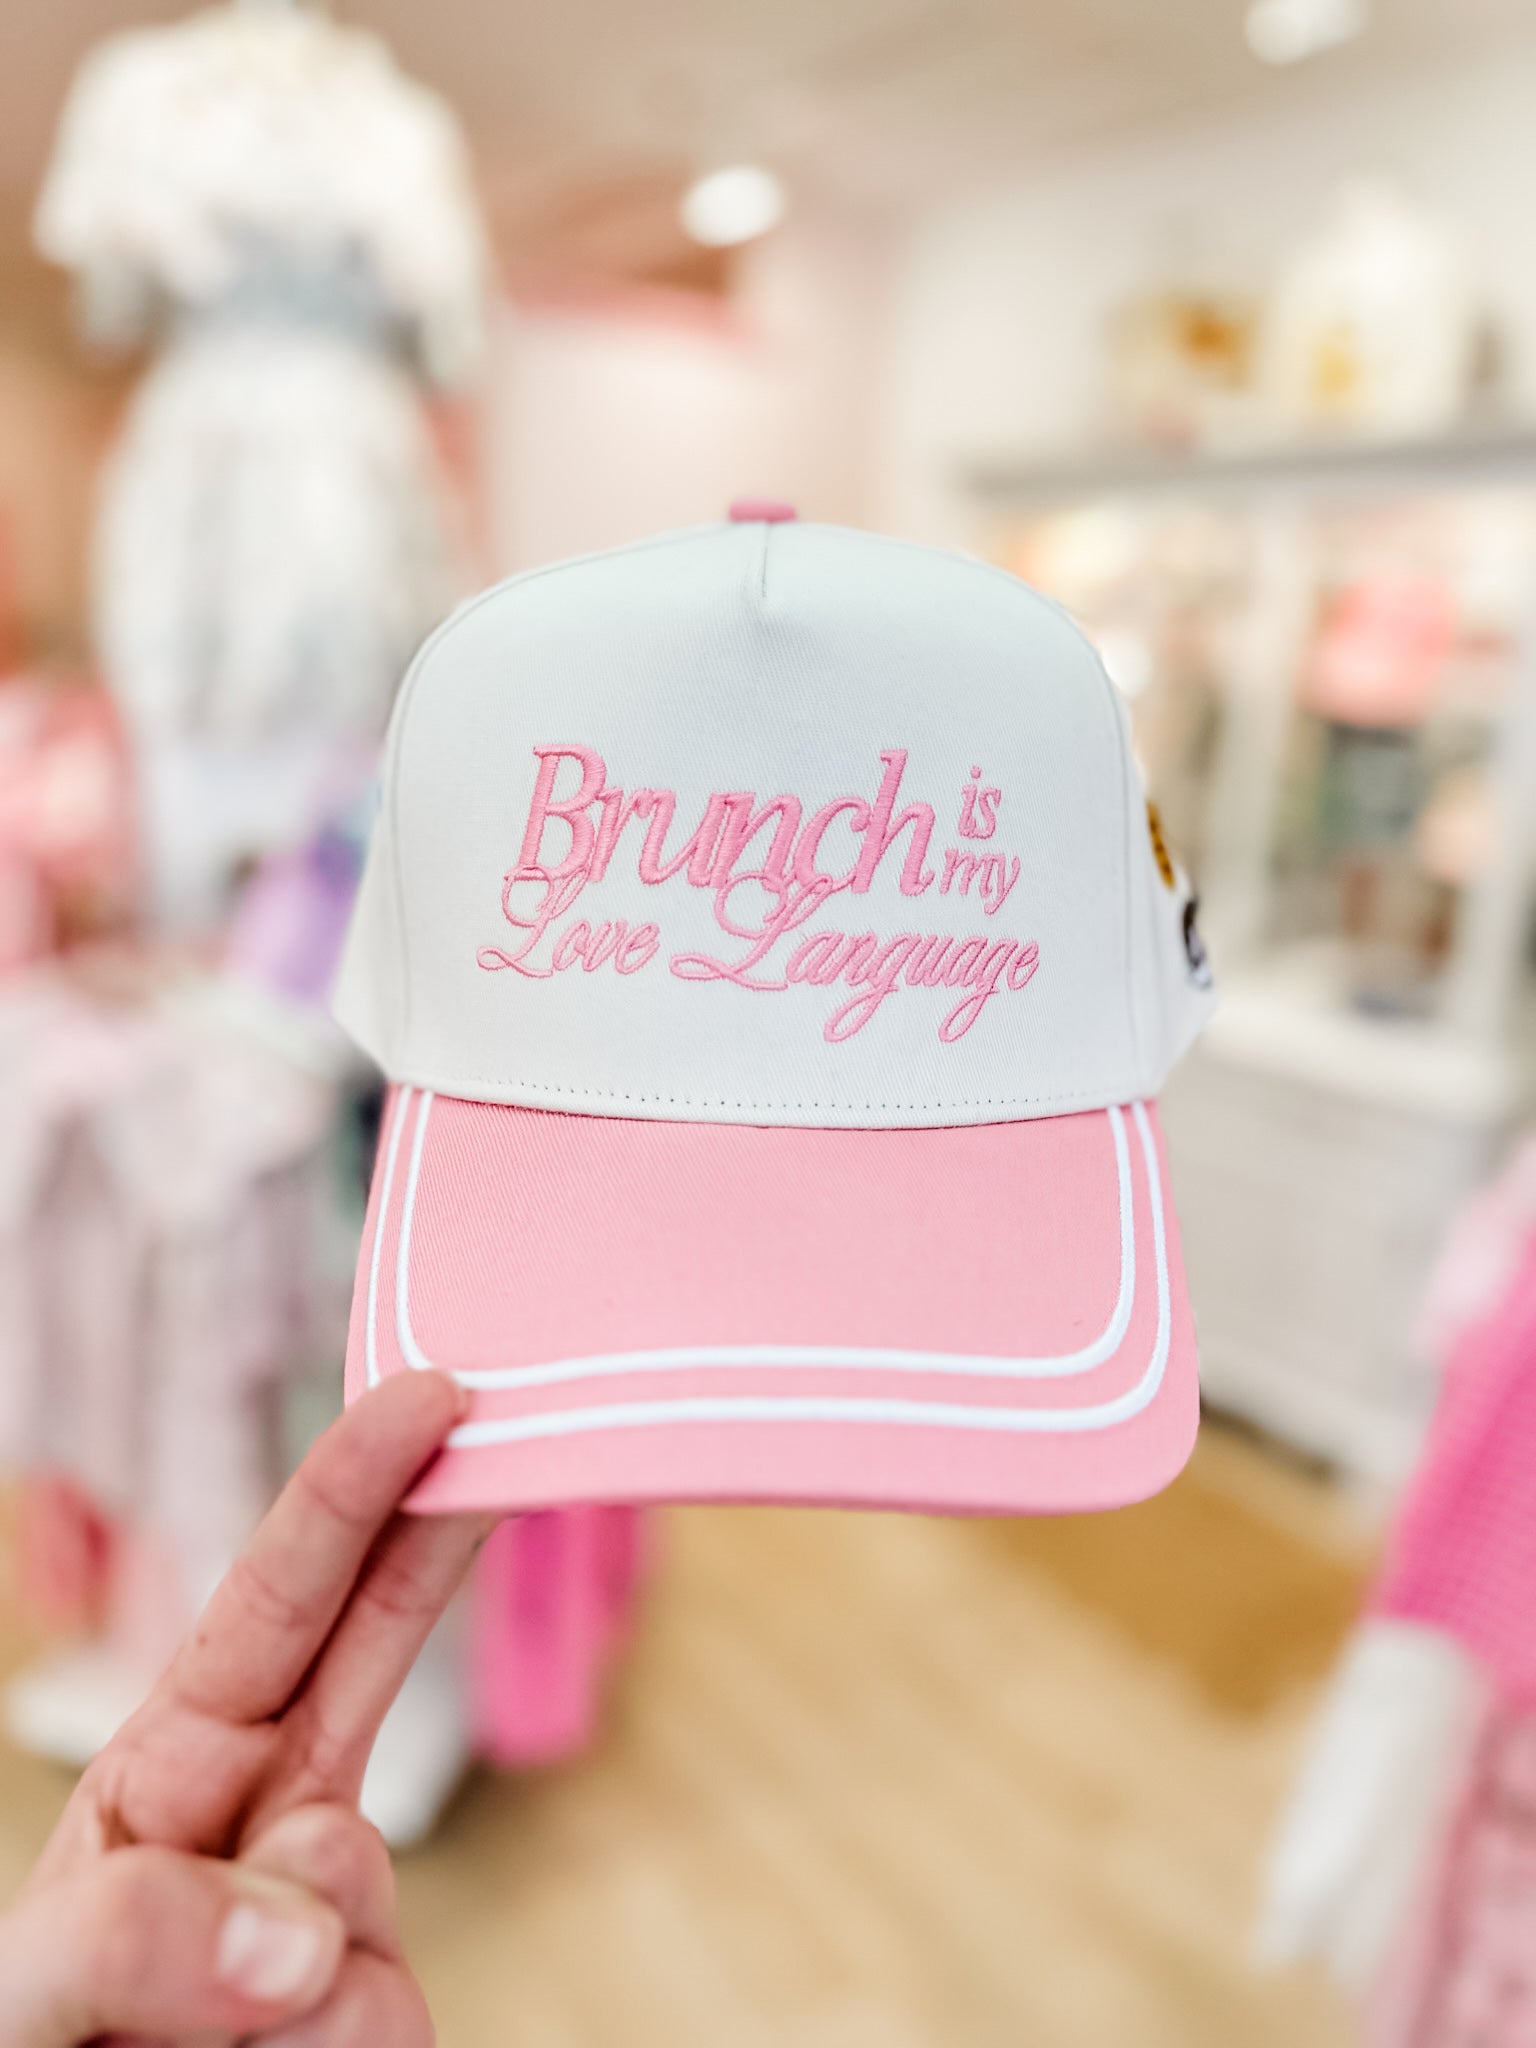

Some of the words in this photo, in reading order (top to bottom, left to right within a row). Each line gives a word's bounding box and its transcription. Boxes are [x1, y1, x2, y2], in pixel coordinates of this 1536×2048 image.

[503, 743, 936, 896] Brunch
[958, 765, 1002, 840] is
[940, 849, 1021, 915] my
[476, 866, 660, 978] Love
[669, 871, 1040, 1043] Language
